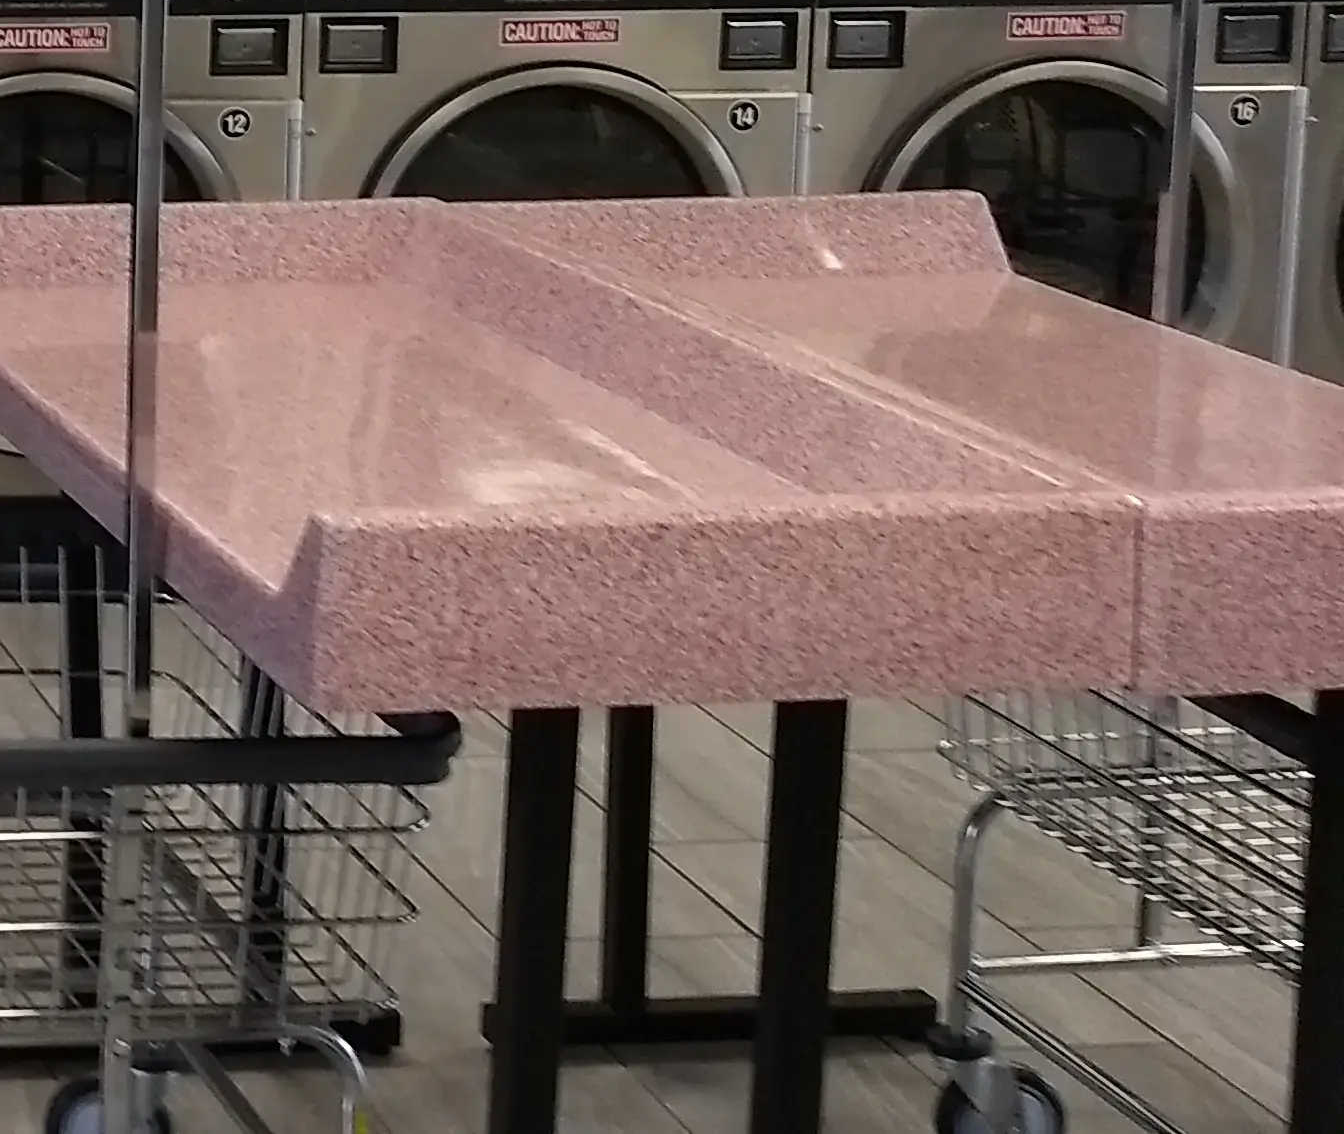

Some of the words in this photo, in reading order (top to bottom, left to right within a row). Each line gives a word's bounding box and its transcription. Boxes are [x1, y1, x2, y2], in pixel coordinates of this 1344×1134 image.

[505, 23, 582, 42] CAUTION:
[1012, 16, 1086, 36] CAUTION:
[733, 108, 754, 126] 14
[1234, 102, 1255, 120] 16
[224, 115, 245, 134] 12
